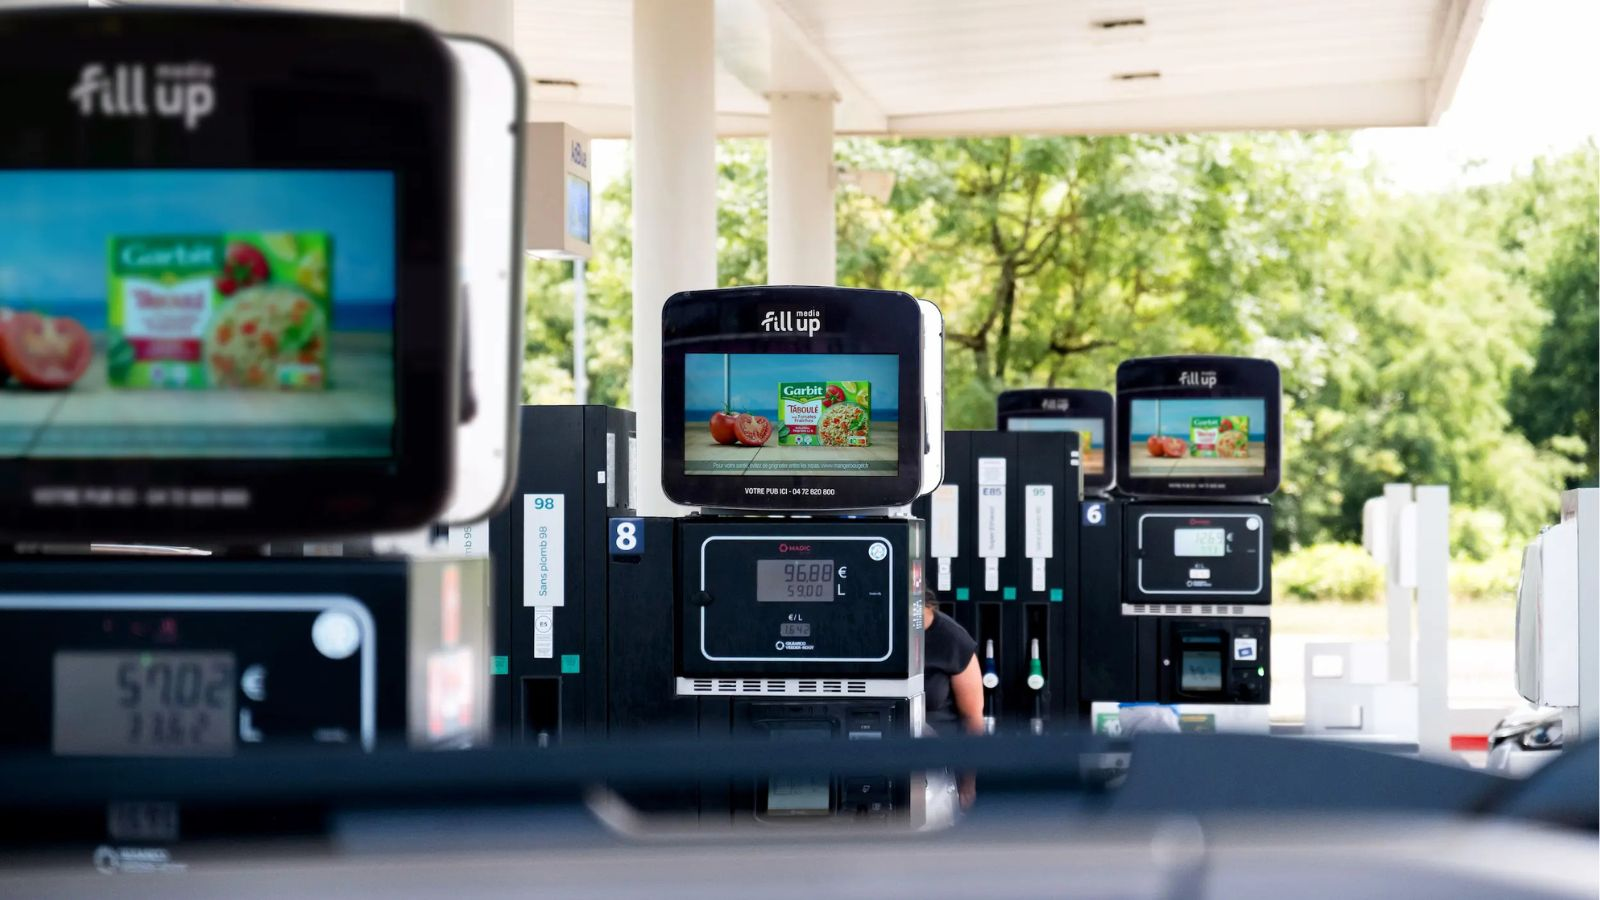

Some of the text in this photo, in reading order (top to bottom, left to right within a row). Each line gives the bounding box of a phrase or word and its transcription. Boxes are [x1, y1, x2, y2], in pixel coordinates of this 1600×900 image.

[70, 63, 216, 129] fill up
[796, 309, 820, 317] media
[761, 311, 820, 337] fill up
[1179, 371, 1217, 389] fill up
[783, 385, 823, 396] Garbit
[744, 487, 765, 495] VOTRE
[766, 487, 779, 495] PUB
[983, 487, 1002, 496] E85
[1033, 488, 1045, 496] 95
[534, 497, 554, 510] 98
[1086, 504, 1102, 524] 6
[615, 522, 637, 550] 8
[539, 526, 549, 597] Sans plomb 98
[838, 566, 848, 578] €
[838, 584, 846, 595] L
[239, 707, 265, 744] L
